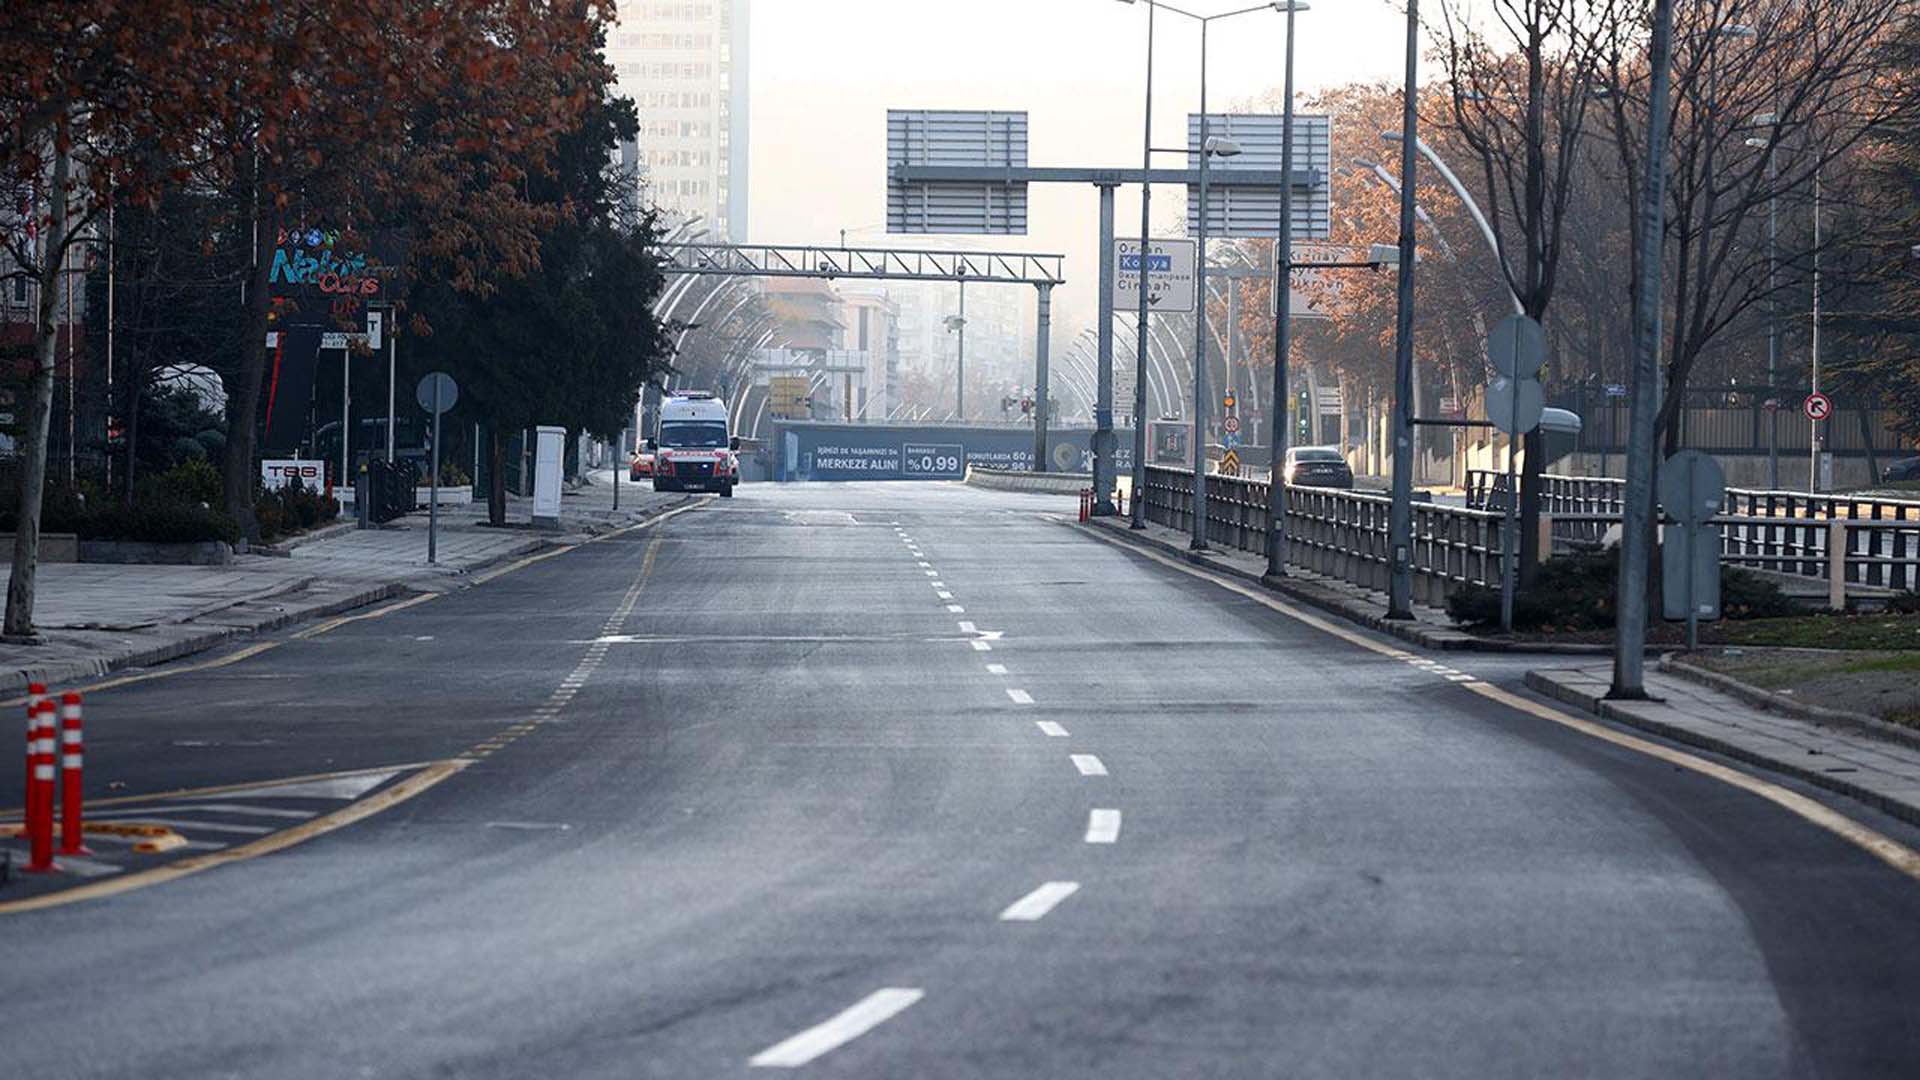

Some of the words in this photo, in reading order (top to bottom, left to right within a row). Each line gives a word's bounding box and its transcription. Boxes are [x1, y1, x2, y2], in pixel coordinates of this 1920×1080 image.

[1122, 257, 1168, 270] Koya
[817, 458, 868, 470] MERKEZE
[907, 455, 958, 472] %0,99
